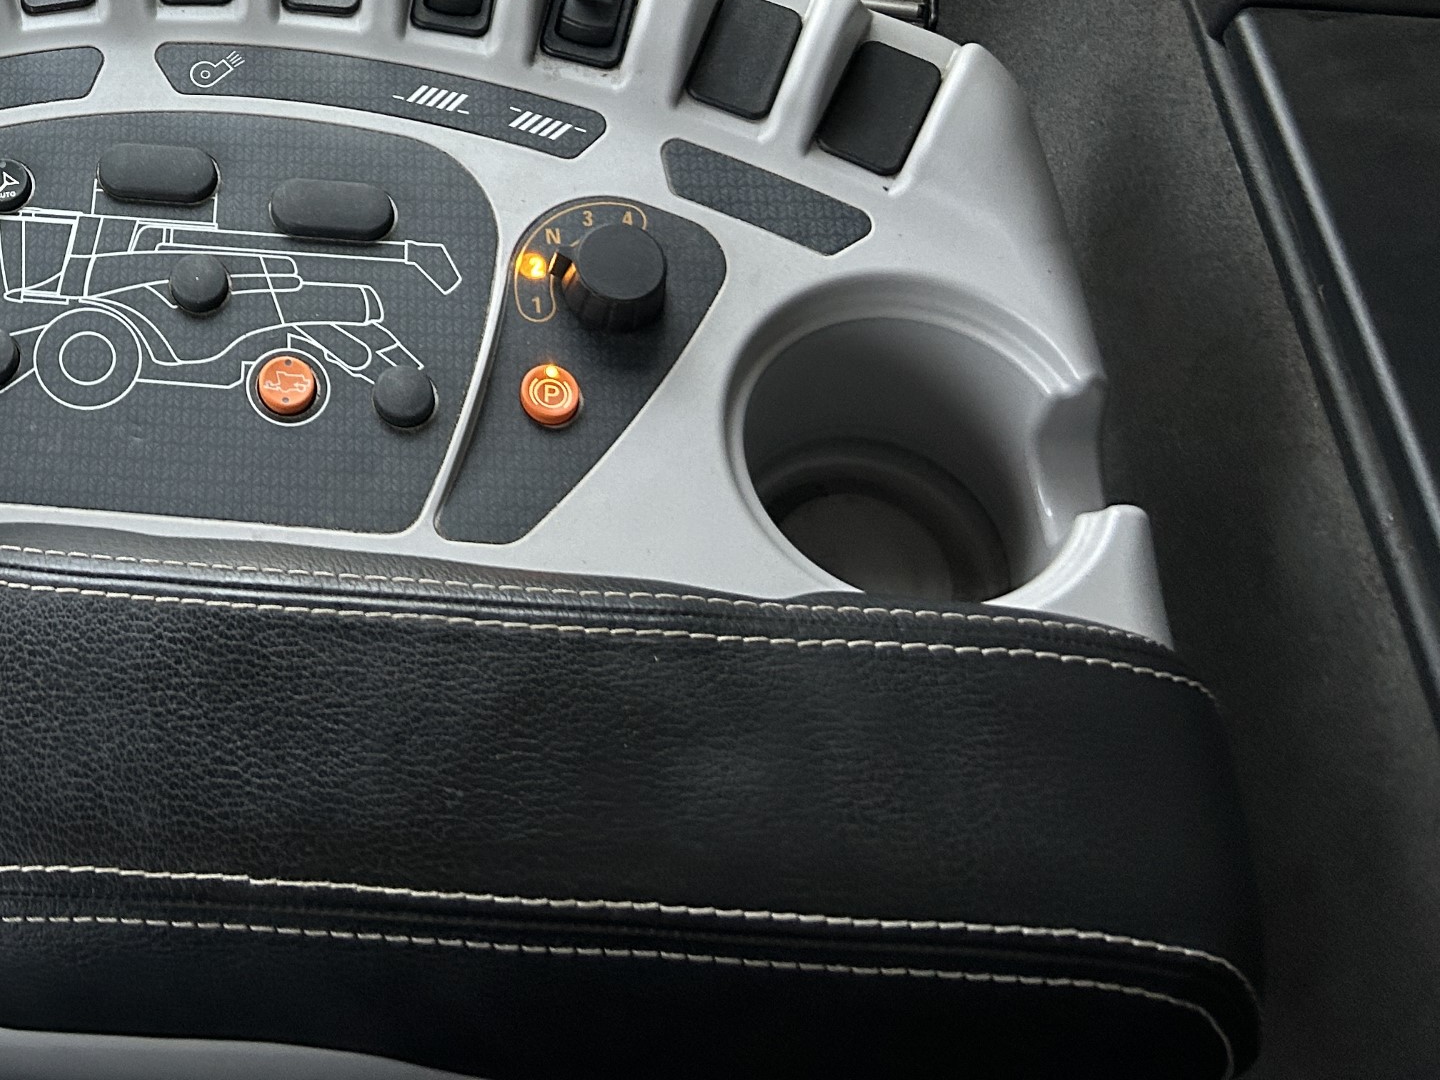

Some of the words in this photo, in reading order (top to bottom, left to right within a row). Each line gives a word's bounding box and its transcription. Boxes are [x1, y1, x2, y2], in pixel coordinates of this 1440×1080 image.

[545, 228, 561, 244] N
[582, 210, 593, 227] 3
[622, 211, 633, 226] 4
[529, 255, 546, 279] 2
[532, 297, 542, 313] 1
[544, 384, 560, 401] P
